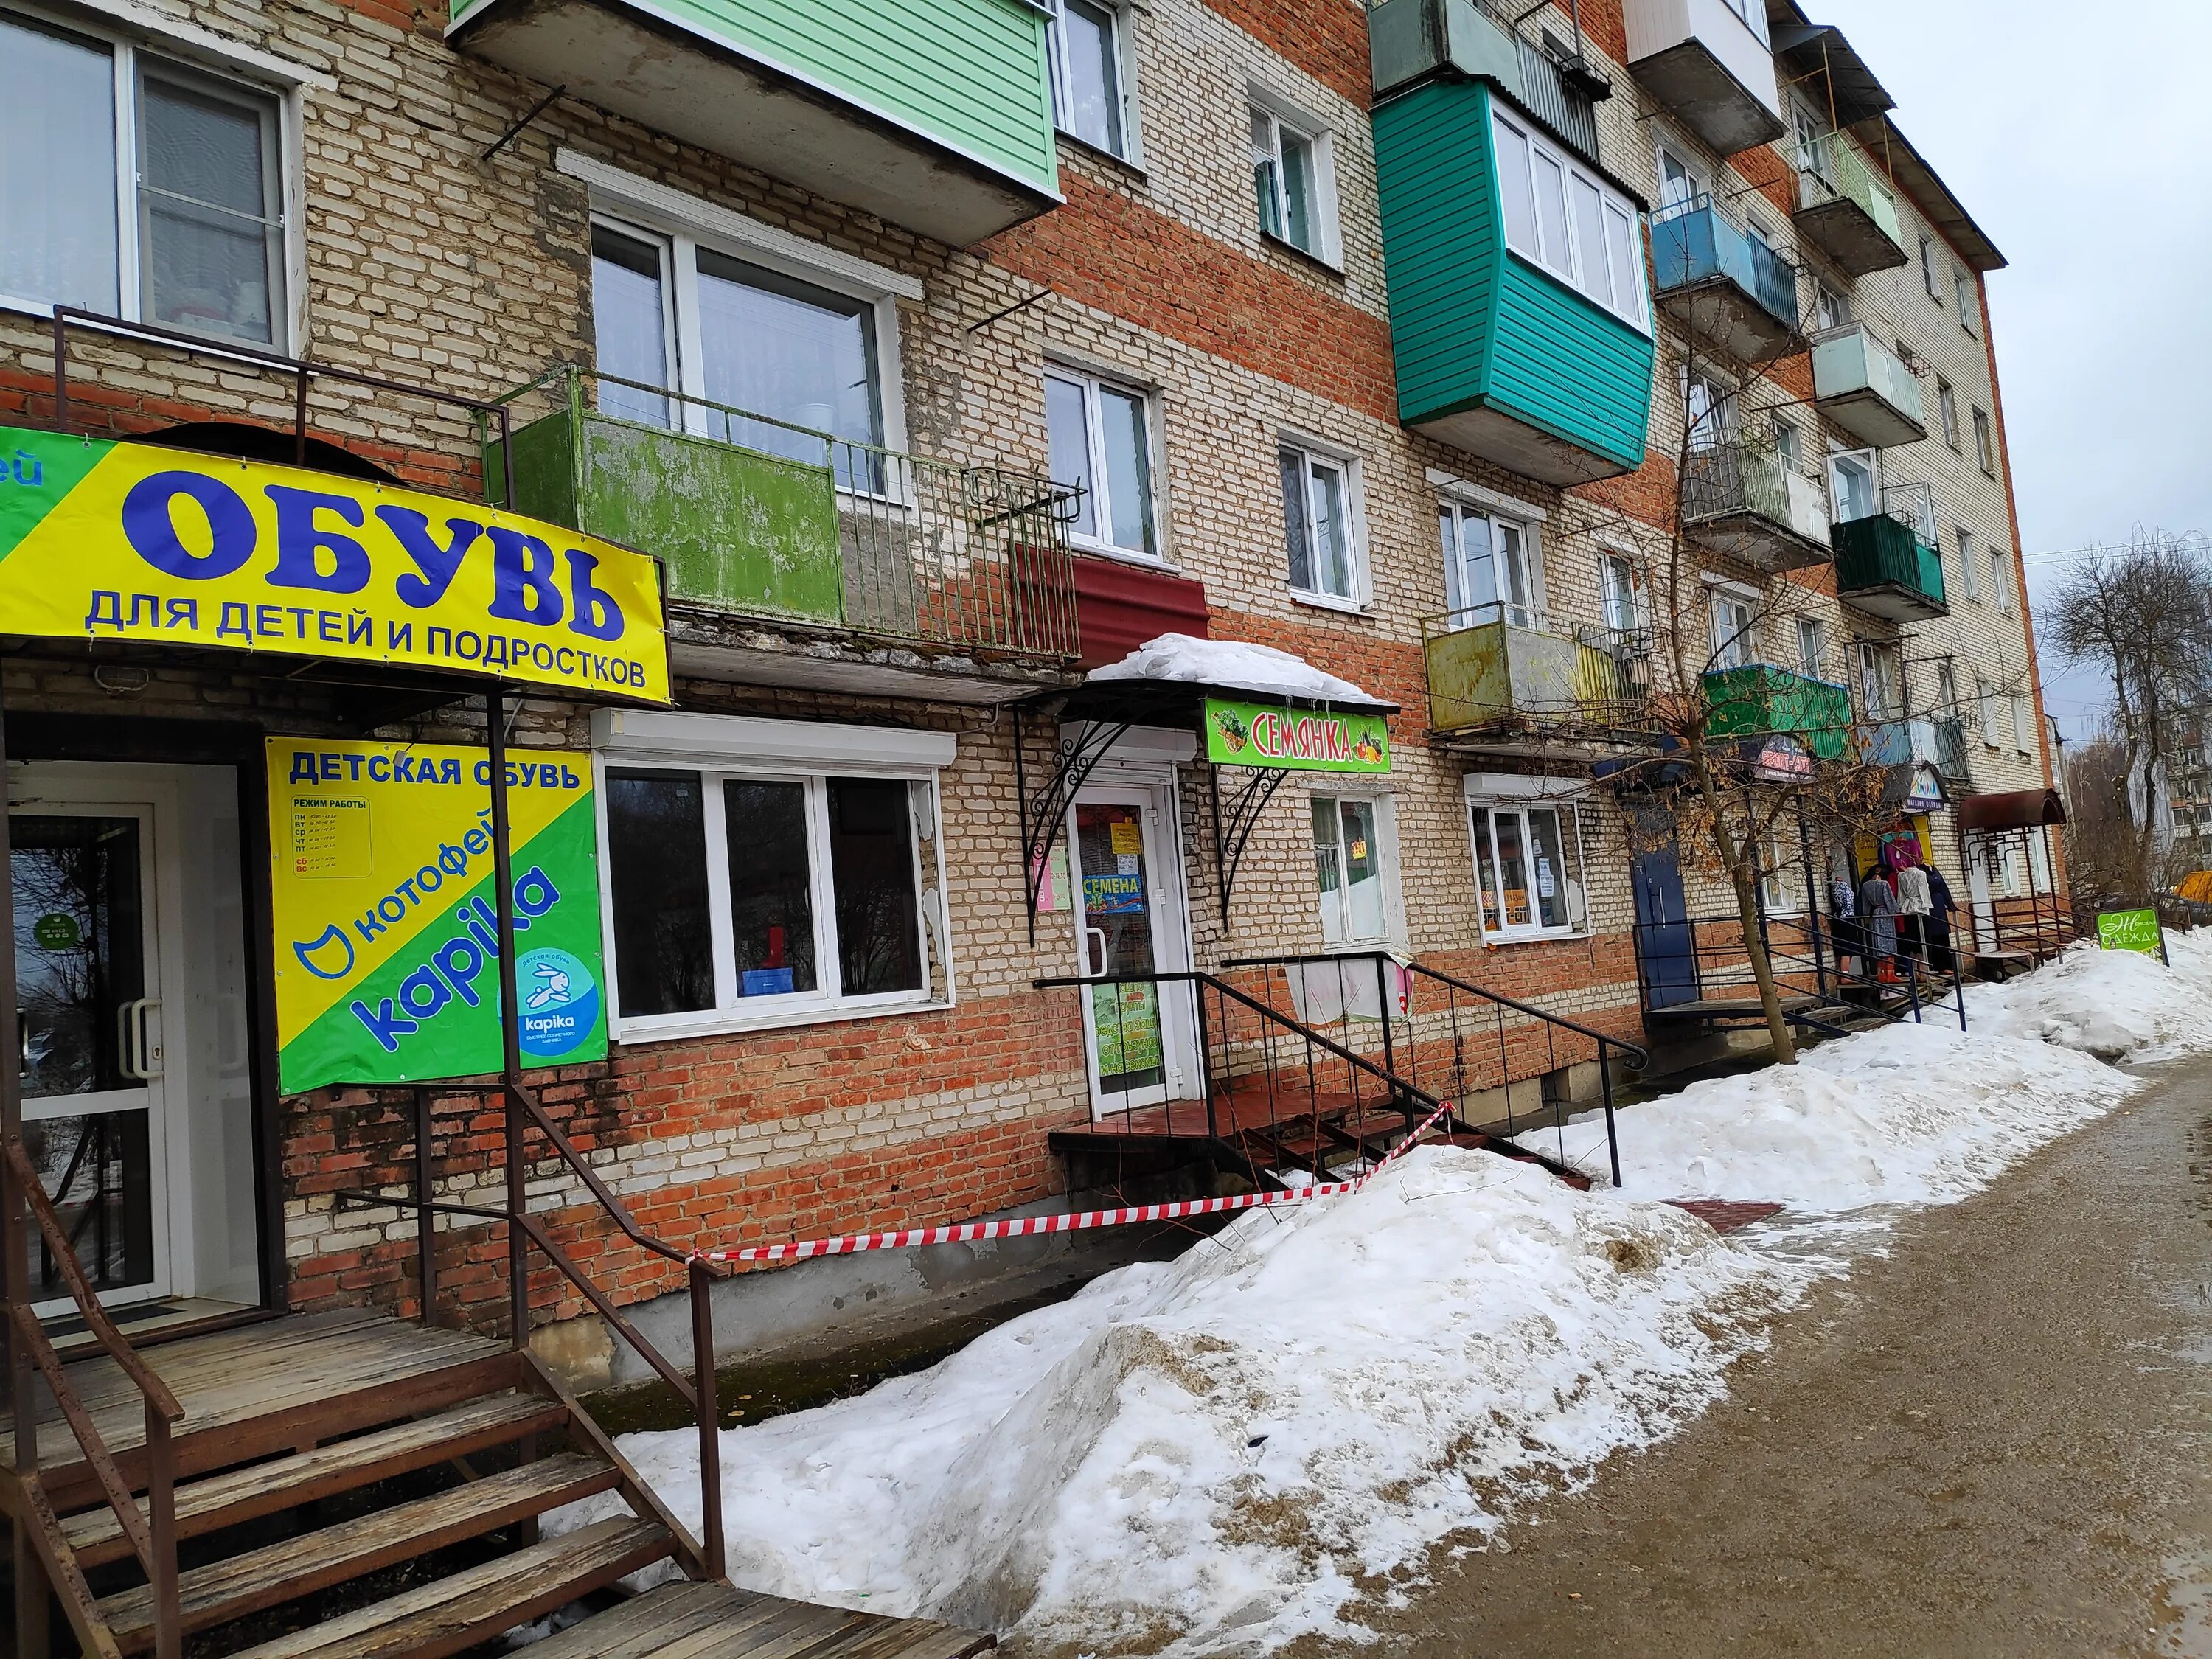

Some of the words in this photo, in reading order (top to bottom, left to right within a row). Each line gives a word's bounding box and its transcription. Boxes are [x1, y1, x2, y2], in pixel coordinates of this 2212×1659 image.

[122, 470, 625, 642] ОБУВЬ
[85, 590, 199, 632] ДЛЯ
[216, 601, 372, 647] ДЕТЕЙ
[388, 620, 412, 653] И
[427, 625, 647, 689] ПОДРОСТКОВ
[1251, 712, 1354, 762] СЕМЯНКА
[289, 751, 462, 785] ДЕТСКАЯ
[474, 759, 580, 789] ОБУВЬ
[293, 799, 327, 807] РЕЖИМ
[329, 800, 366, 809] РАБОТЫ
[1083, 878, 1138, 894] СЕМЕНА
[2102, 931, 2157, 945] ОДЕЖДА
[350, 866, 560, 1053] kapika
[522, 953, 549, 967] детская
[551, 953, 571, 964] обувь
[525, 1015, 574, 1034] kapika
[1102, 1043, 1115, 1057] от
